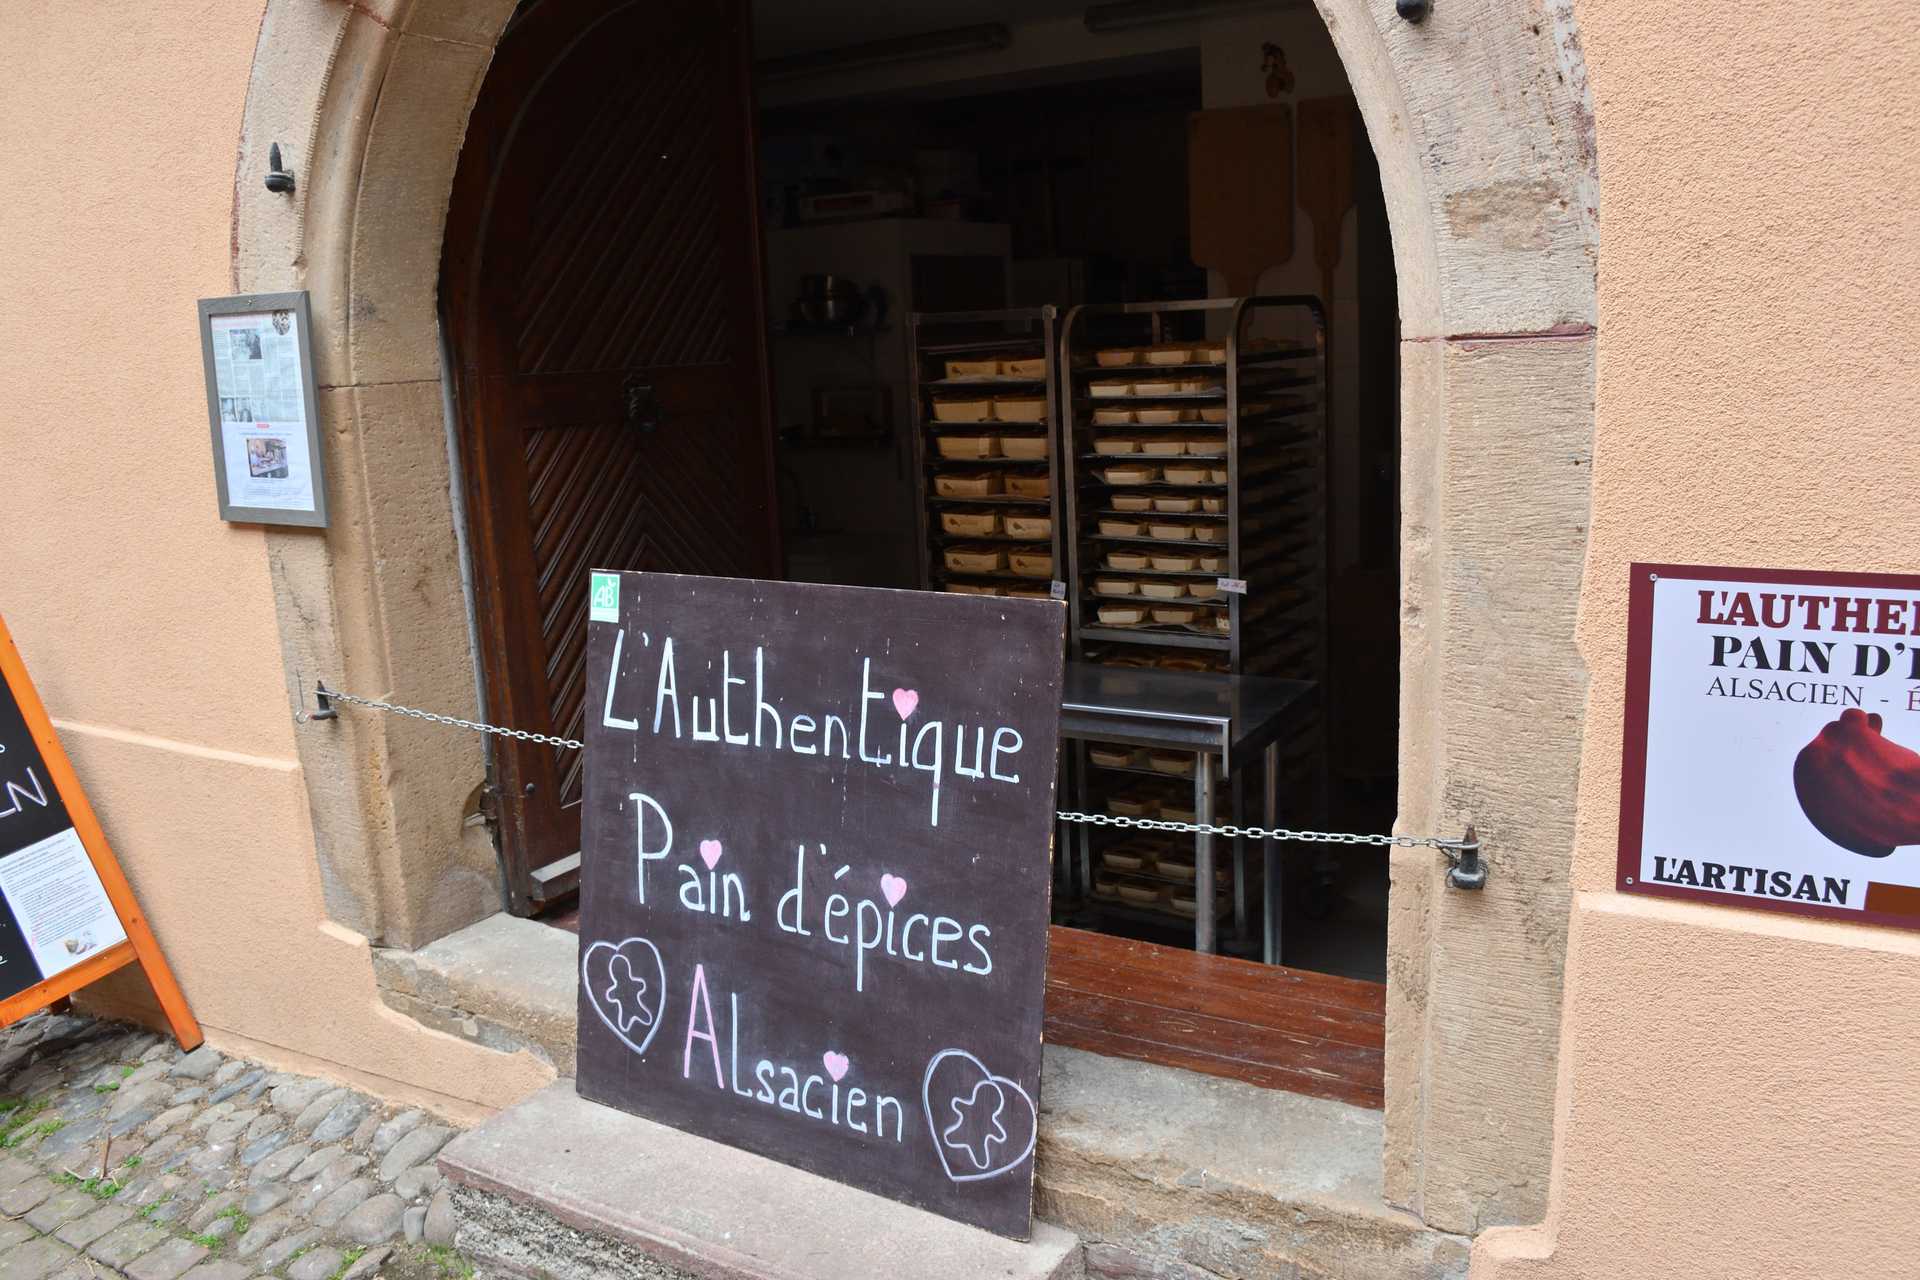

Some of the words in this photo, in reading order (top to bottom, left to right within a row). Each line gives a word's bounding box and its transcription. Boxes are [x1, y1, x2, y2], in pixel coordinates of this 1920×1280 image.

[1709, 635, 1837, 675] PAIN
[1705, 676, 1865, 707] ALSACIEN
[603, 629, 1023, 827] L'Authentique
[629, 793, 751, 922] Pain
[776, 844, 993, 992] d'épices
[1652, 855, 1850, 906] L'ARTISAN
